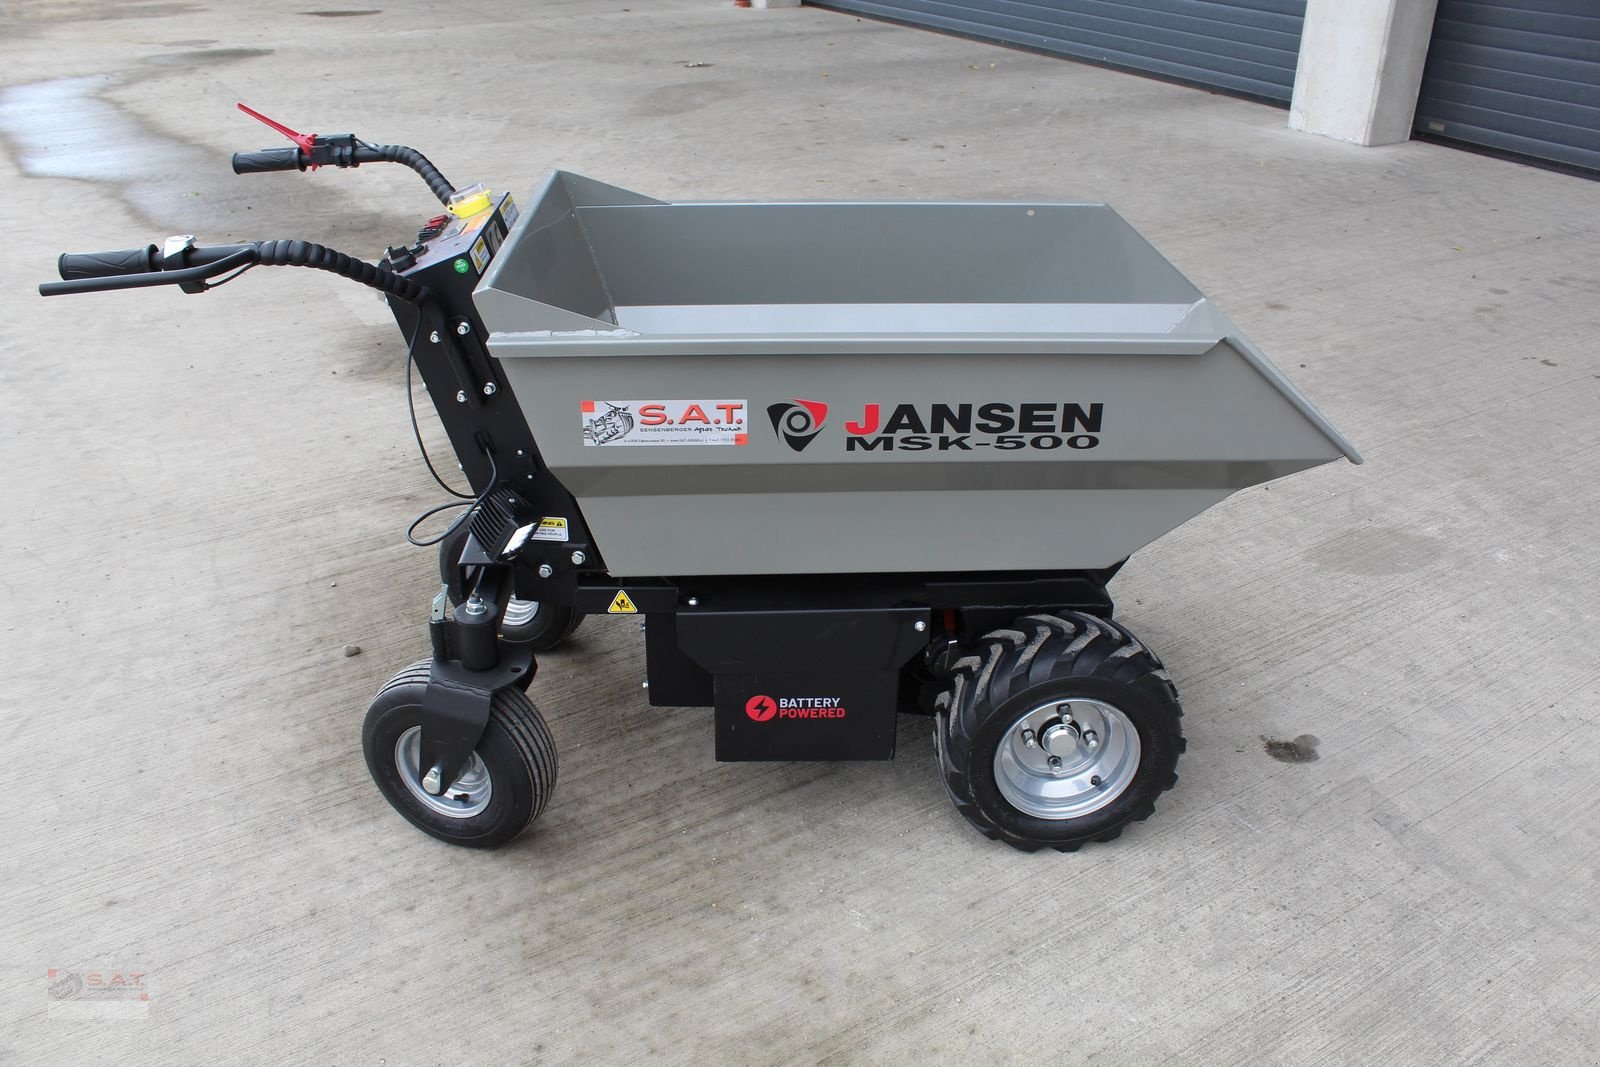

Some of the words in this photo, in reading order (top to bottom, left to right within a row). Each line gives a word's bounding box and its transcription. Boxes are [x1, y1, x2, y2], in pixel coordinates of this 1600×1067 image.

[639, 404, 743, 425] S.A.T.
[845, 403, 1104, 435] JANSEN
[846, 435, 1100, 451] MSK-500
[780, 698, 840, 708] BATTERY
[780, 708, 846, 718] POWERED
